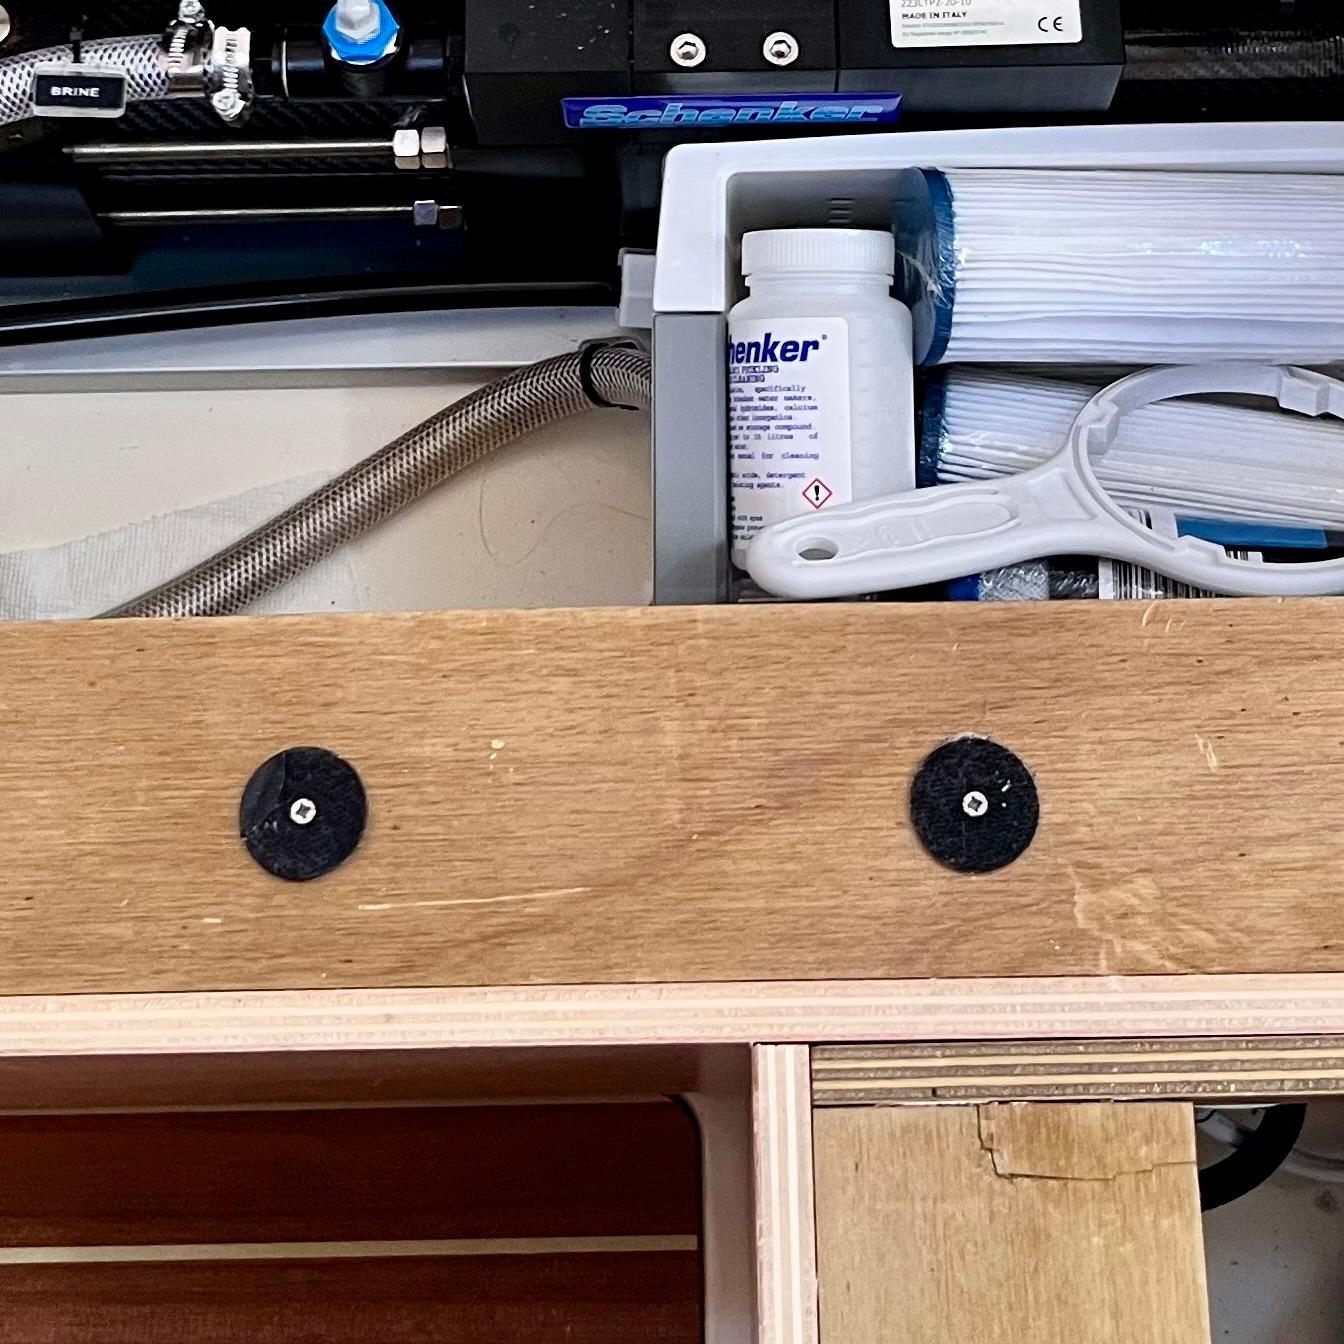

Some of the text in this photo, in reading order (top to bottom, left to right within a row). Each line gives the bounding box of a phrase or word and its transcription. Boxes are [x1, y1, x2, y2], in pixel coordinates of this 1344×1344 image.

[929, 11, 940, 19] IN
[942, 10, 968, 19] ITALY
[50, 86, 100, 98] BRINE
[579, 101, 884, 128] Schenker
